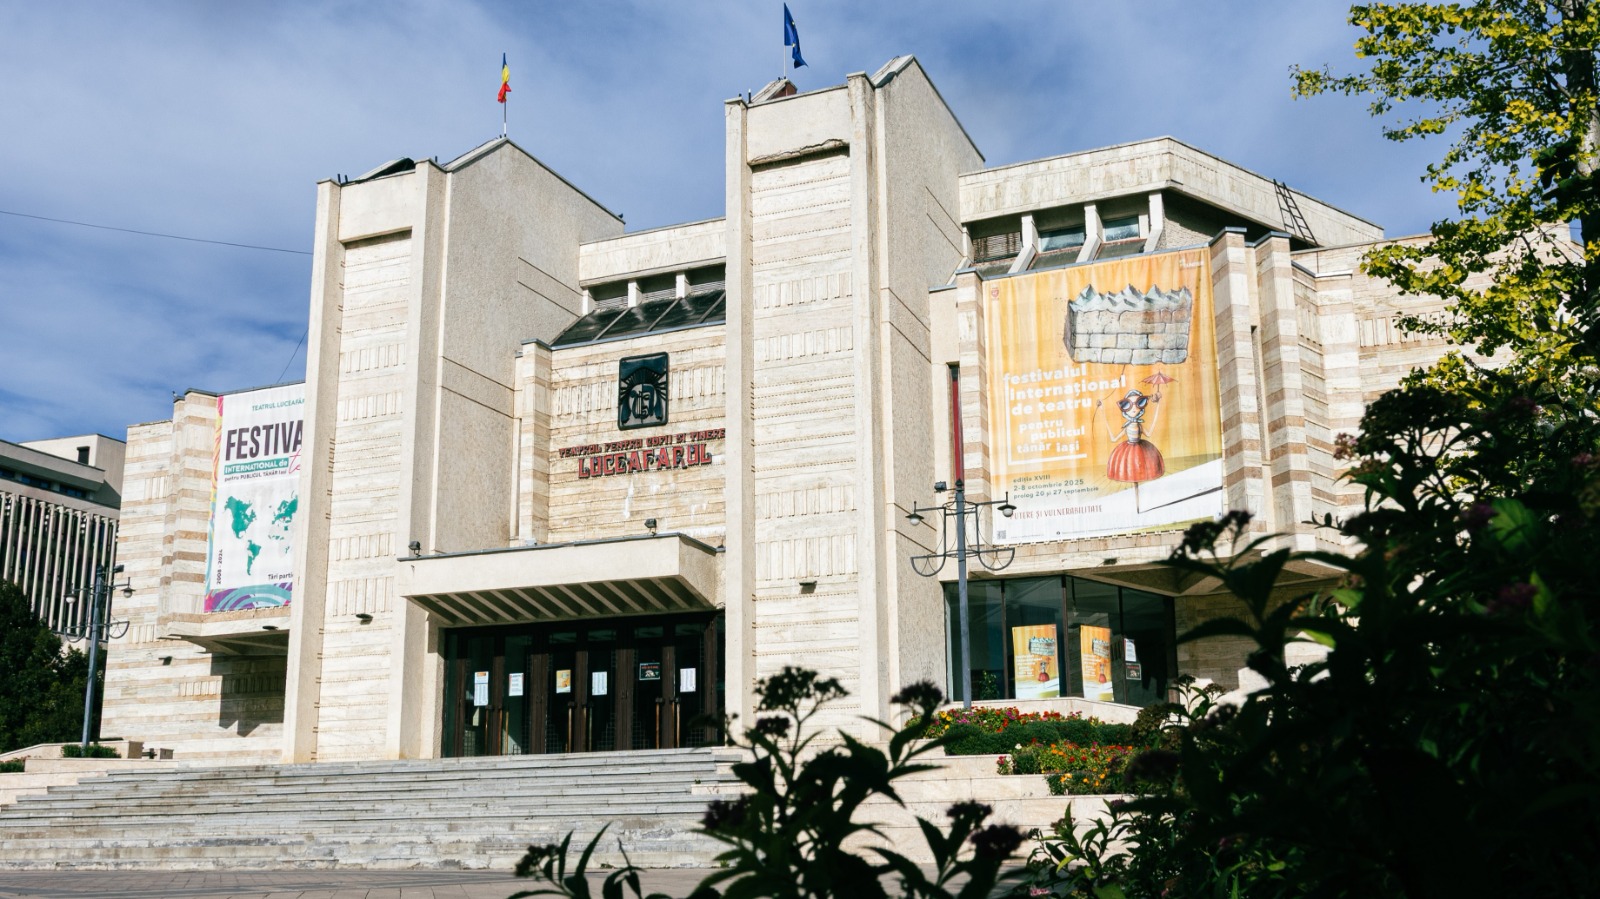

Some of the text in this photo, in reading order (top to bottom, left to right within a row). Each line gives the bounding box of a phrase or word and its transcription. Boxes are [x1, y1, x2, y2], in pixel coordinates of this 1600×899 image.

[1003, 363, 1088, 385] festivalul
[252, 403, 276, 411] TEATRUL
[1011, 397, 1092, 416] de teatru
[1019, 419, 1064, 434] pentru
[225, 419, 304, 461] FESTIVA
[1030, 425, 1085, 443] publicul
[559, 443, 603, 459] TEATRUL
[604, 438, 643, 453] PENTRU
[646, 434, 673, 448] COPII
[279, 459, 288, 467] de
[240, 471, 262, 480] PUBLICUL
[1027, 482, 1063, 490] octombrie
[1064, 479, 1084, 487] 2025
[1013, 492, 1034, 500] prolog
[1063, 486, 1099, 495] septembrie
[1044, 504, 1103, 517] VULNERABILITATE
